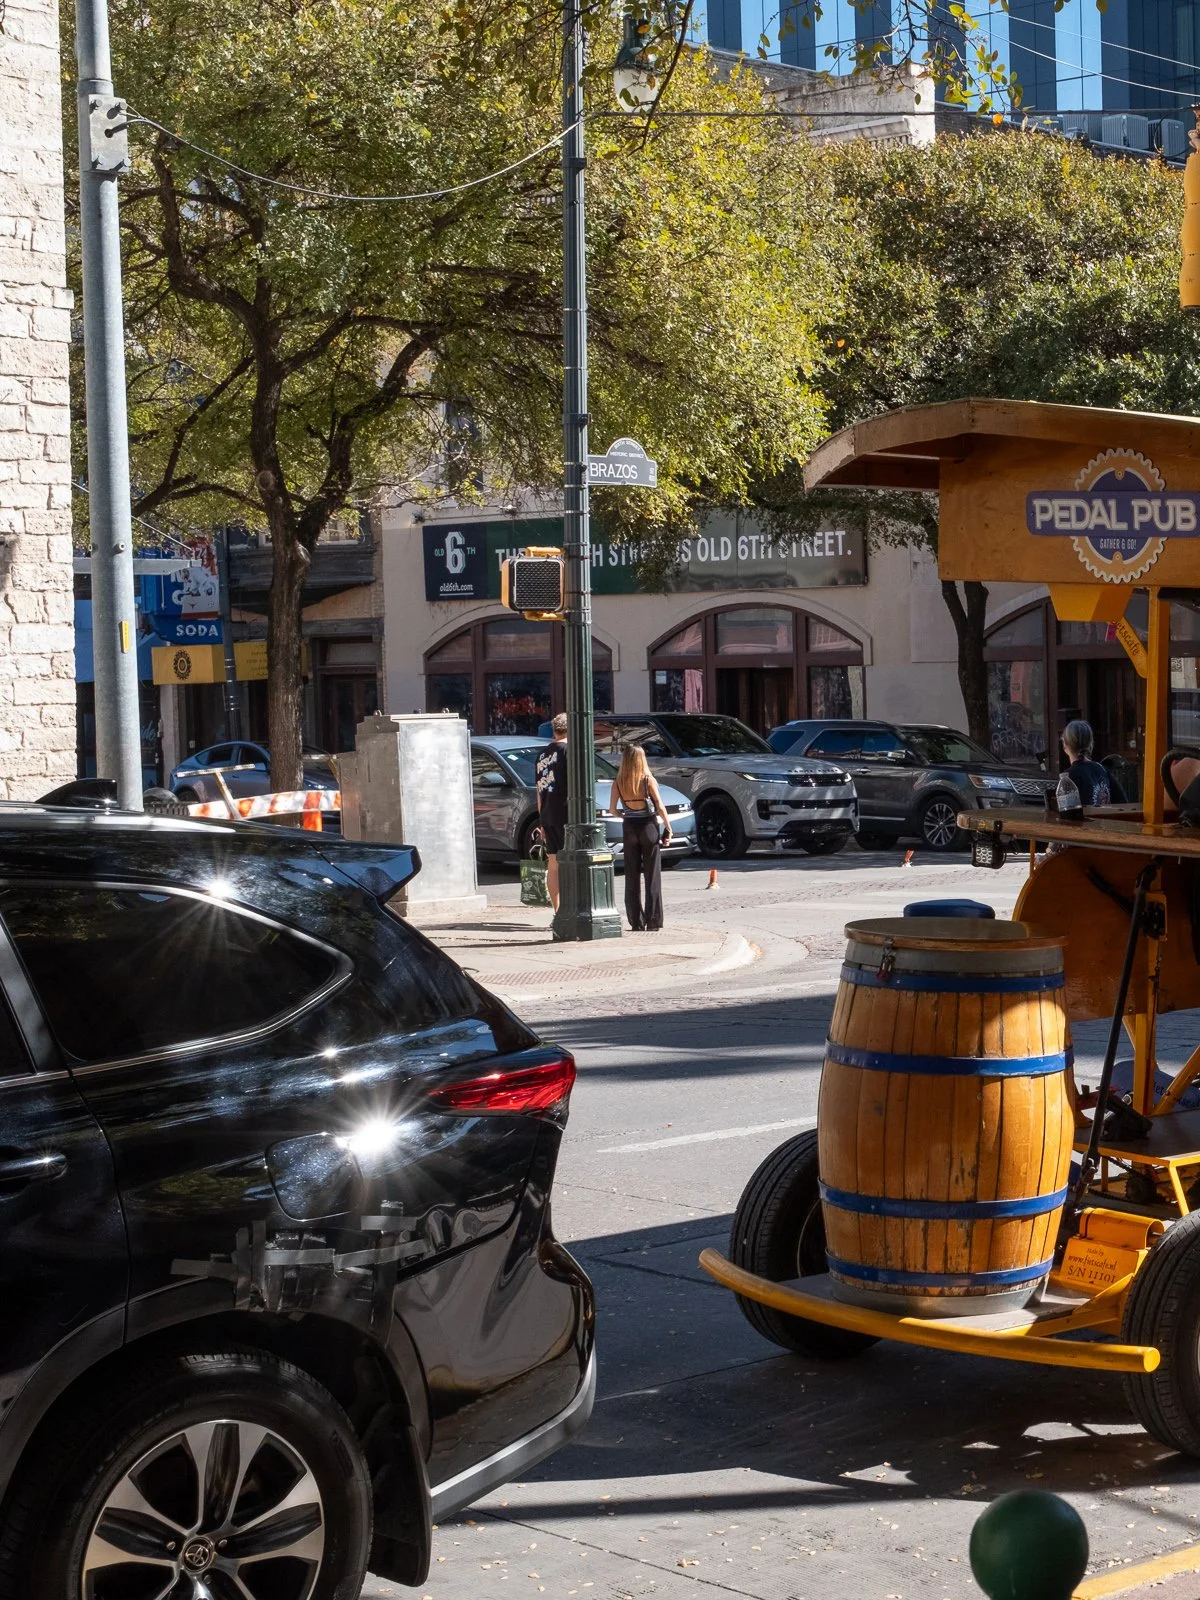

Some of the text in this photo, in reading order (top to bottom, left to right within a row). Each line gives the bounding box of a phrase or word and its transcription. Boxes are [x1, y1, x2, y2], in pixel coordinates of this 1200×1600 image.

[590, 463, 638, 479] BRAZOS
[1032, 498, 1198, 531] PEDAL PUB
[697, 536, 732, 562] OLD
[737, 534, 773, 560] 6TH
[1099, 538, 1120, 549] GATHER
[1127, 538, 1137, 550] GO!
[434, 548, 444, 557] OLD
[440, 582, 474, 592] old6th.com
[176, 624, 218, 637] SODA
[1067, 1266, 1086, 1278] S/N
